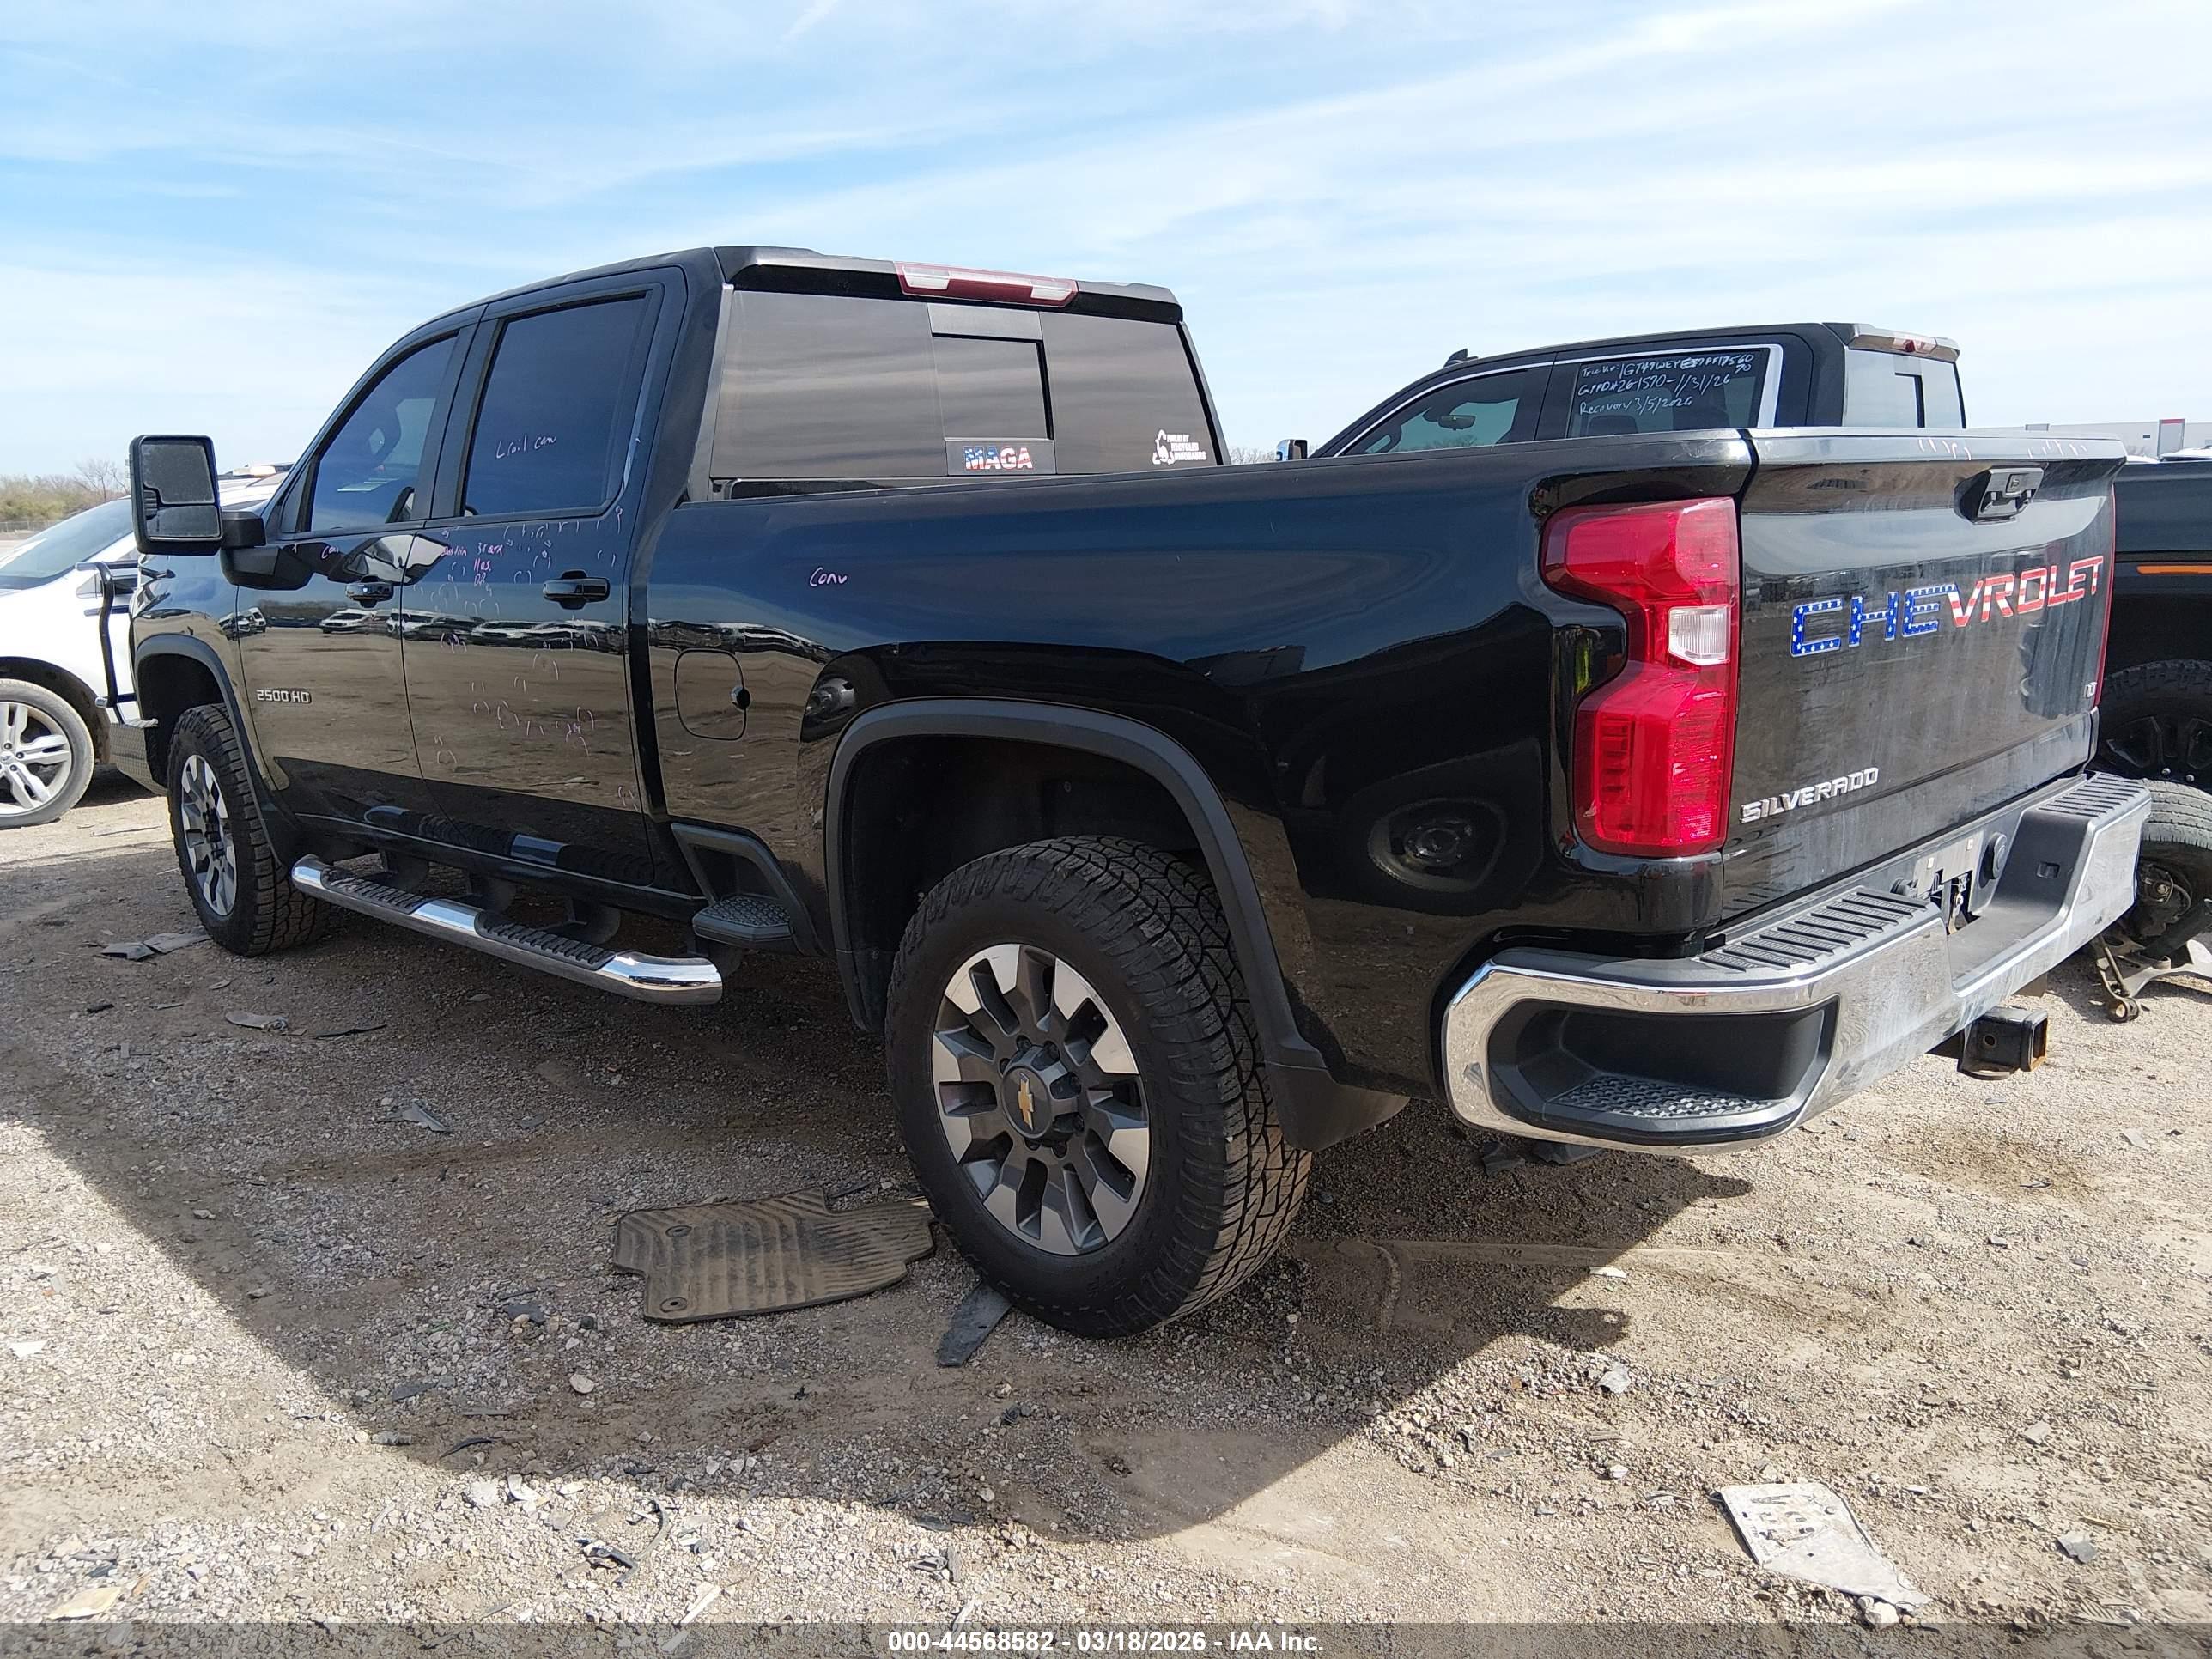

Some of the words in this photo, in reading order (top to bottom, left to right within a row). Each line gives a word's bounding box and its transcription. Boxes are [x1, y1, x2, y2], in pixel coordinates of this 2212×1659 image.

[963, 445, 1035, 471] MAGA
[1790, 555, 2104, 658] CHEVROLET
[256, 689, 290, 702] 2500
[292, 690, 311, 704] HD
[1739, 767, 1880, 824] SILVERADO
